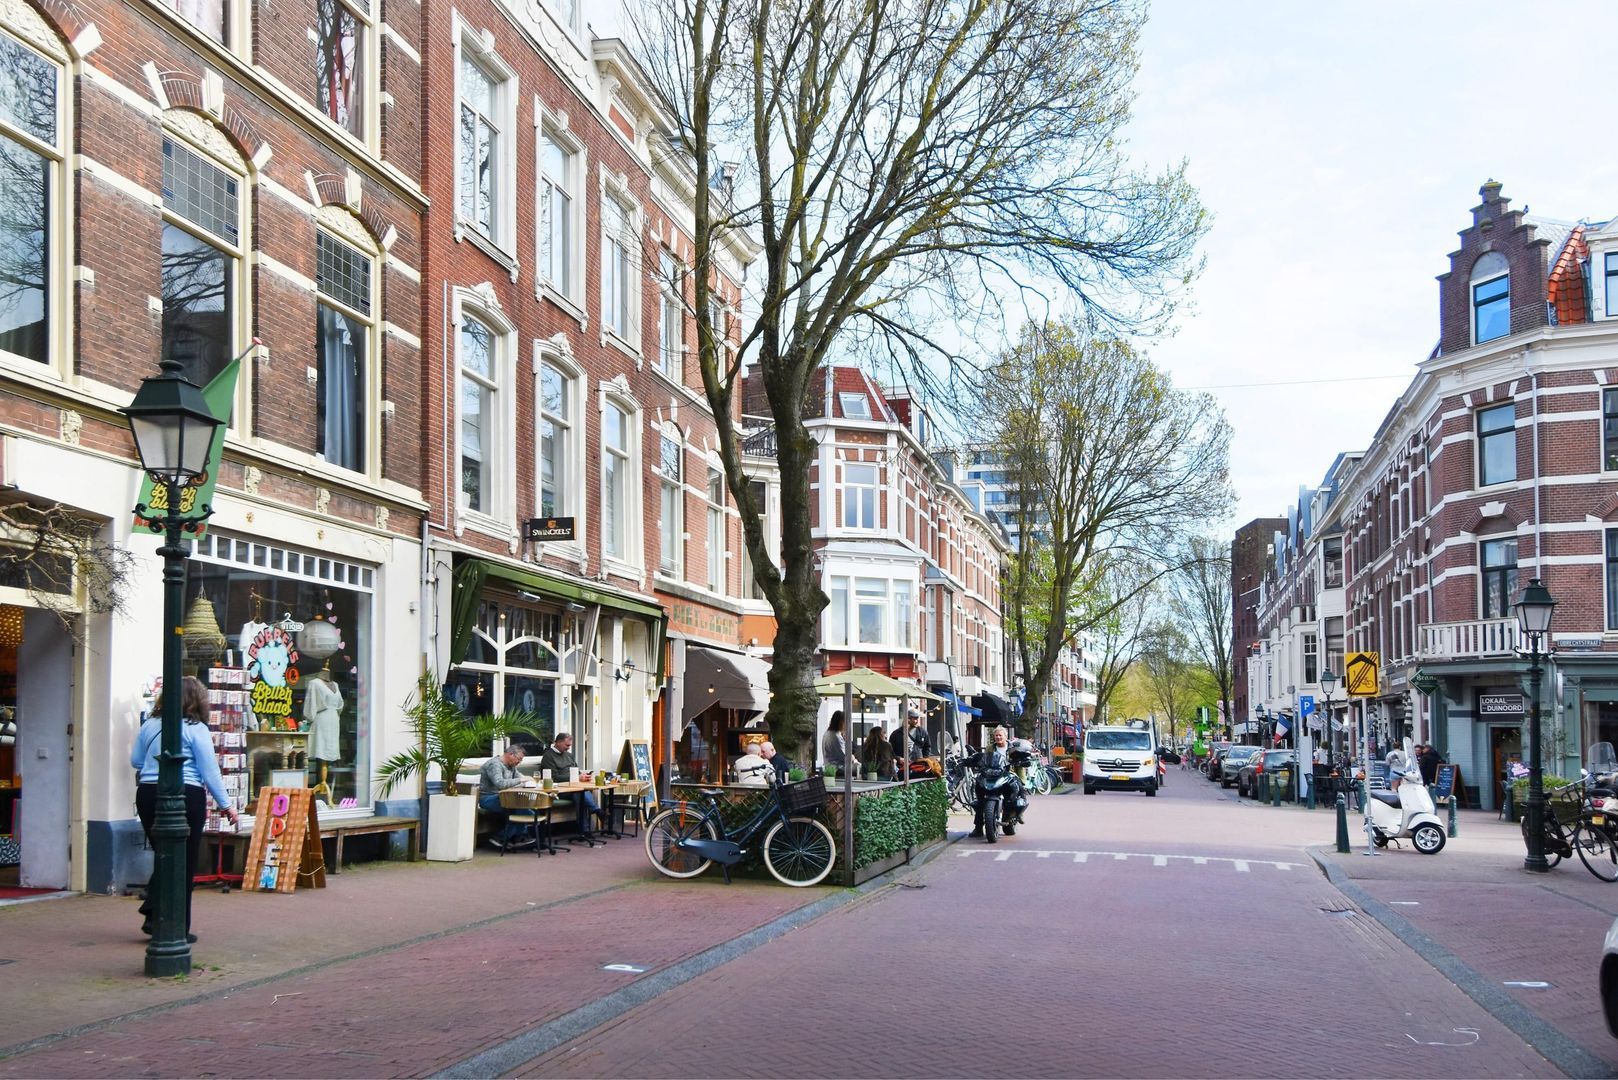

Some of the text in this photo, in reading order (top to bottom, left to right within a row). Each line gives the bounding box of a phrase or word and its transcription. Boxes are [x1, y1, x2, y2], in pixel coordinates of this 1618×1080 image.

[248, 627, 299, 664] BUBBELS
[253, 681, 293, 702] Bellen
[1304, 702, 1310, 710] P
[259, 794, 289, 889] OPEN
